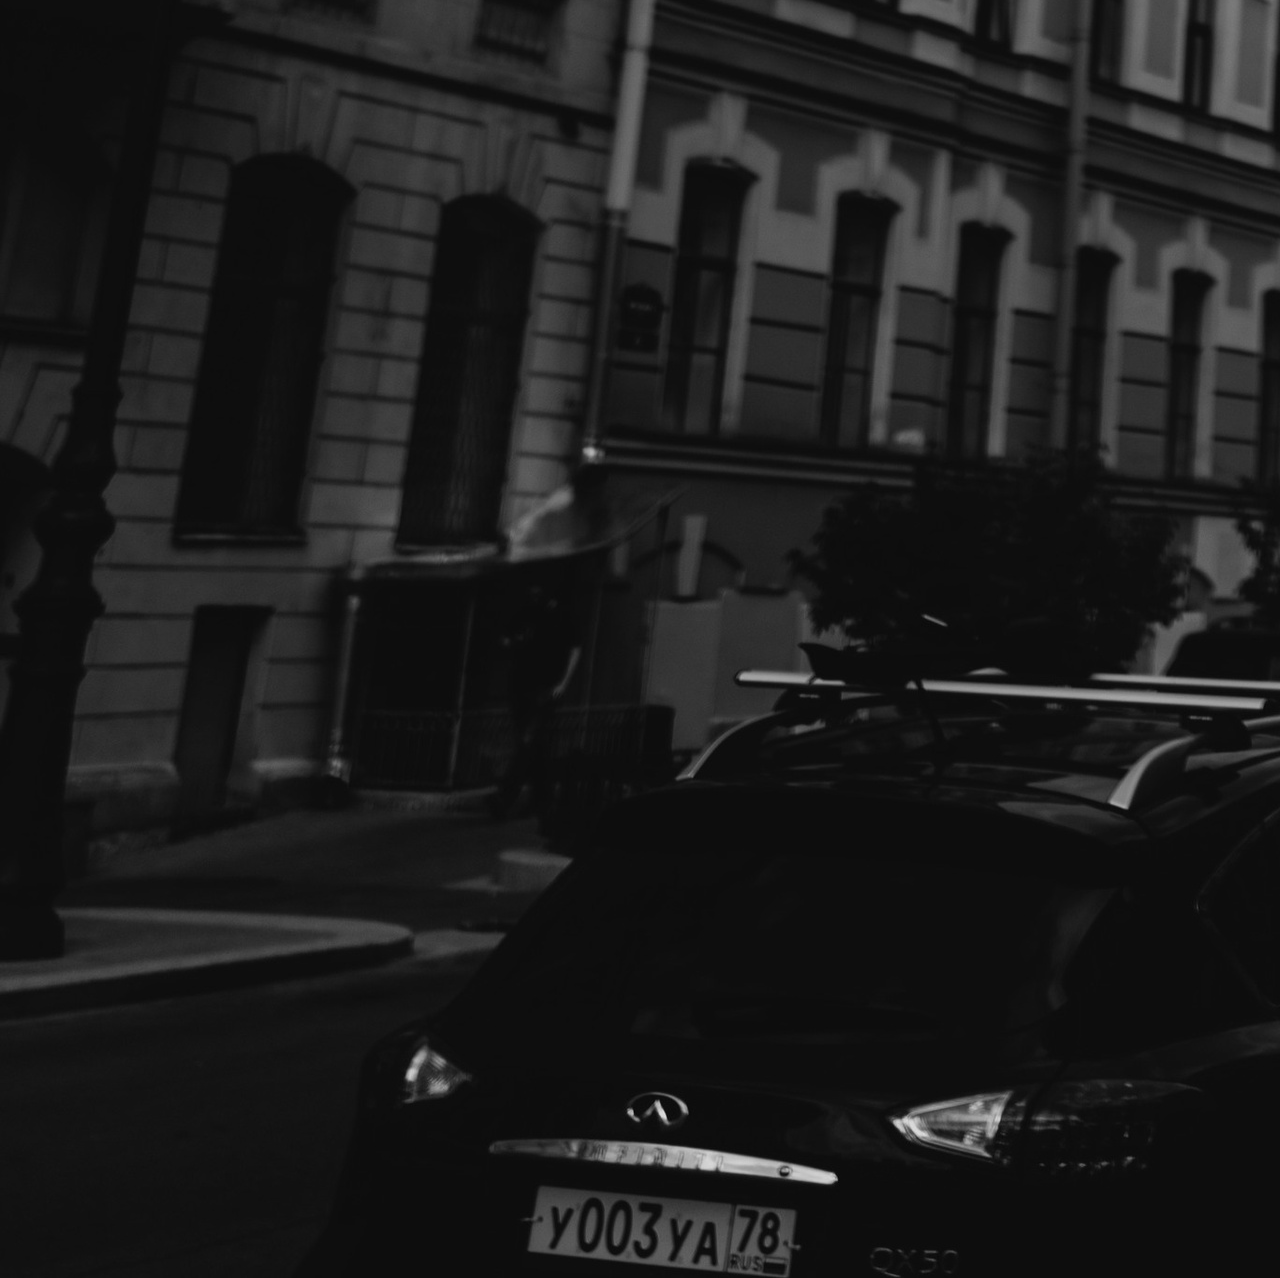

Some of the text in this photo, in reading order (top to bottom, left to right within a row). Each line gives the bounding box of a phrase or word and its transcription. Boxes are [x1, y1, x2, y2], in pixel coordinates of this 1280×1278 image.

[737, 1209, 780, 1254] 78
[729, 1254, 763, 1271] RUS
[869, 1246, 959, 1278] QX50
